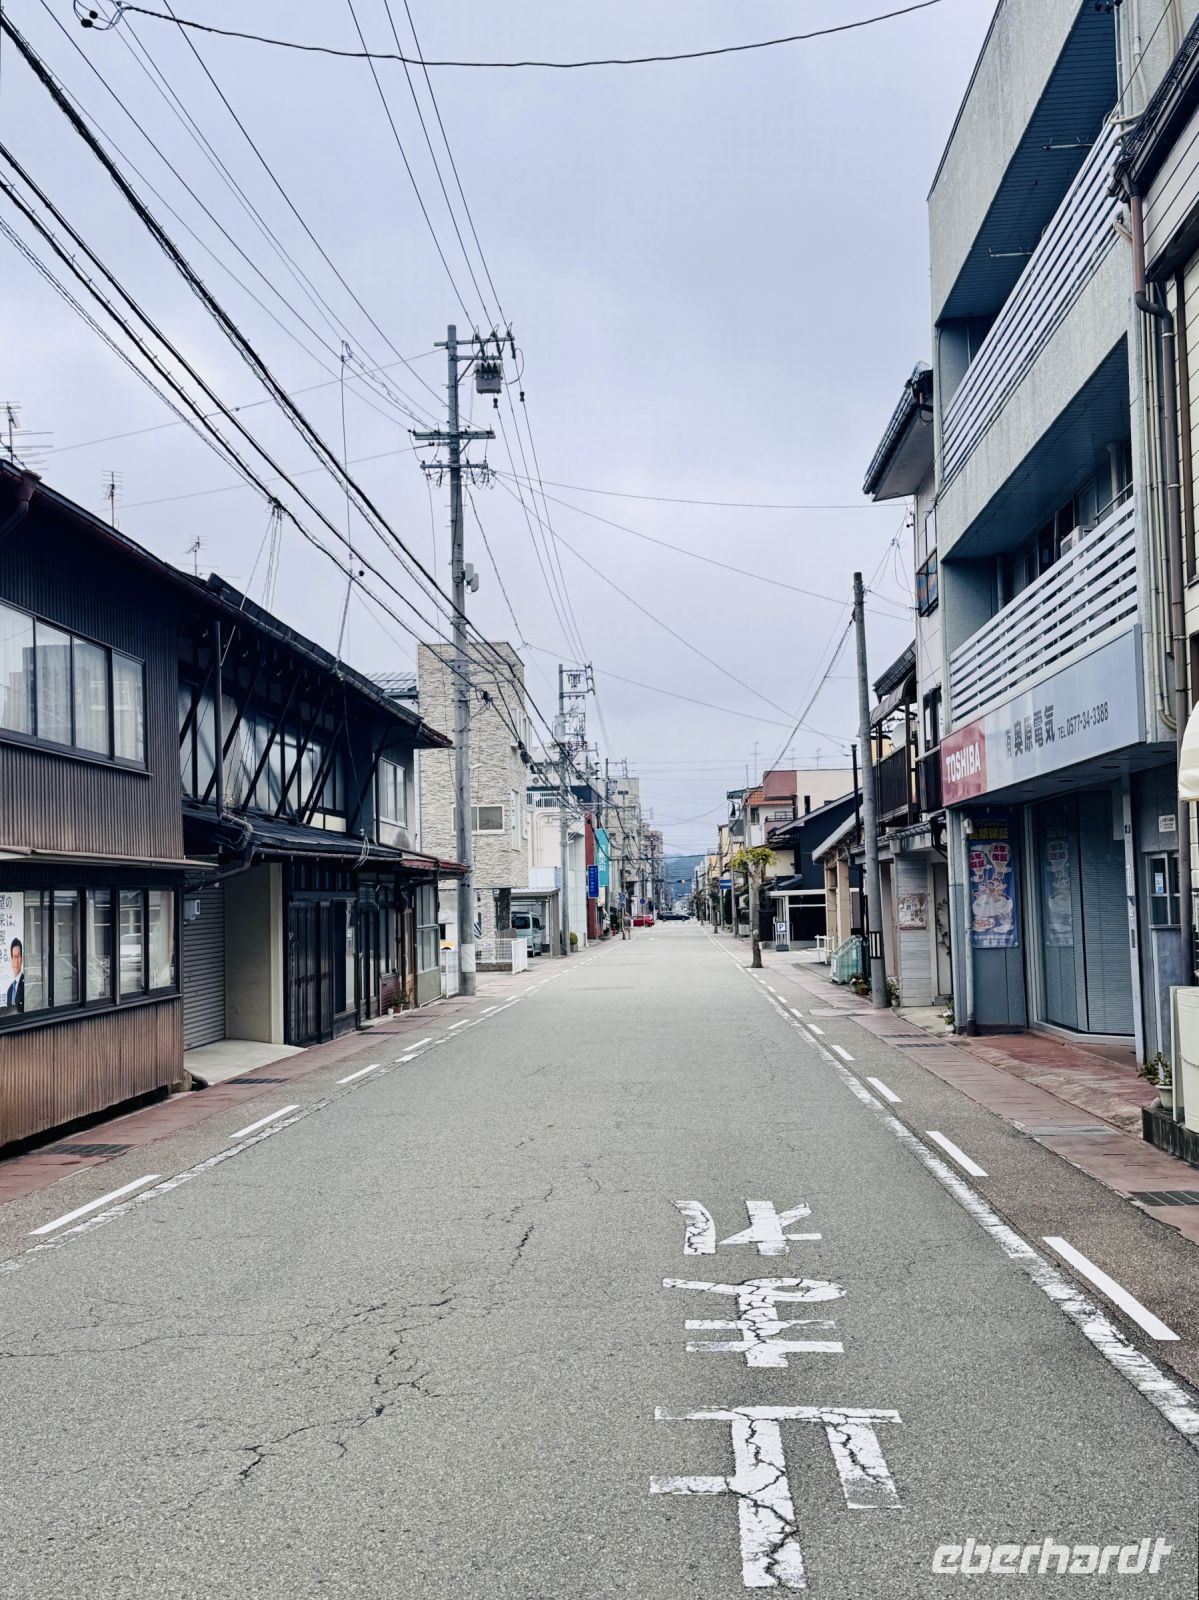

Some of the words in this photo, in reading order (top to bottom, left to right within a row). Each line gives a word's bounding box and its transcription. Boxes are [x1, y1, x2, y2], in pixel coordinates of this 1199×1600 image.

[1058, 726, 1067, 740] TEL
[1066, 701, 1109, 737] 0577-34-3388
[946, 742, 981, 784] TOSHIBA
